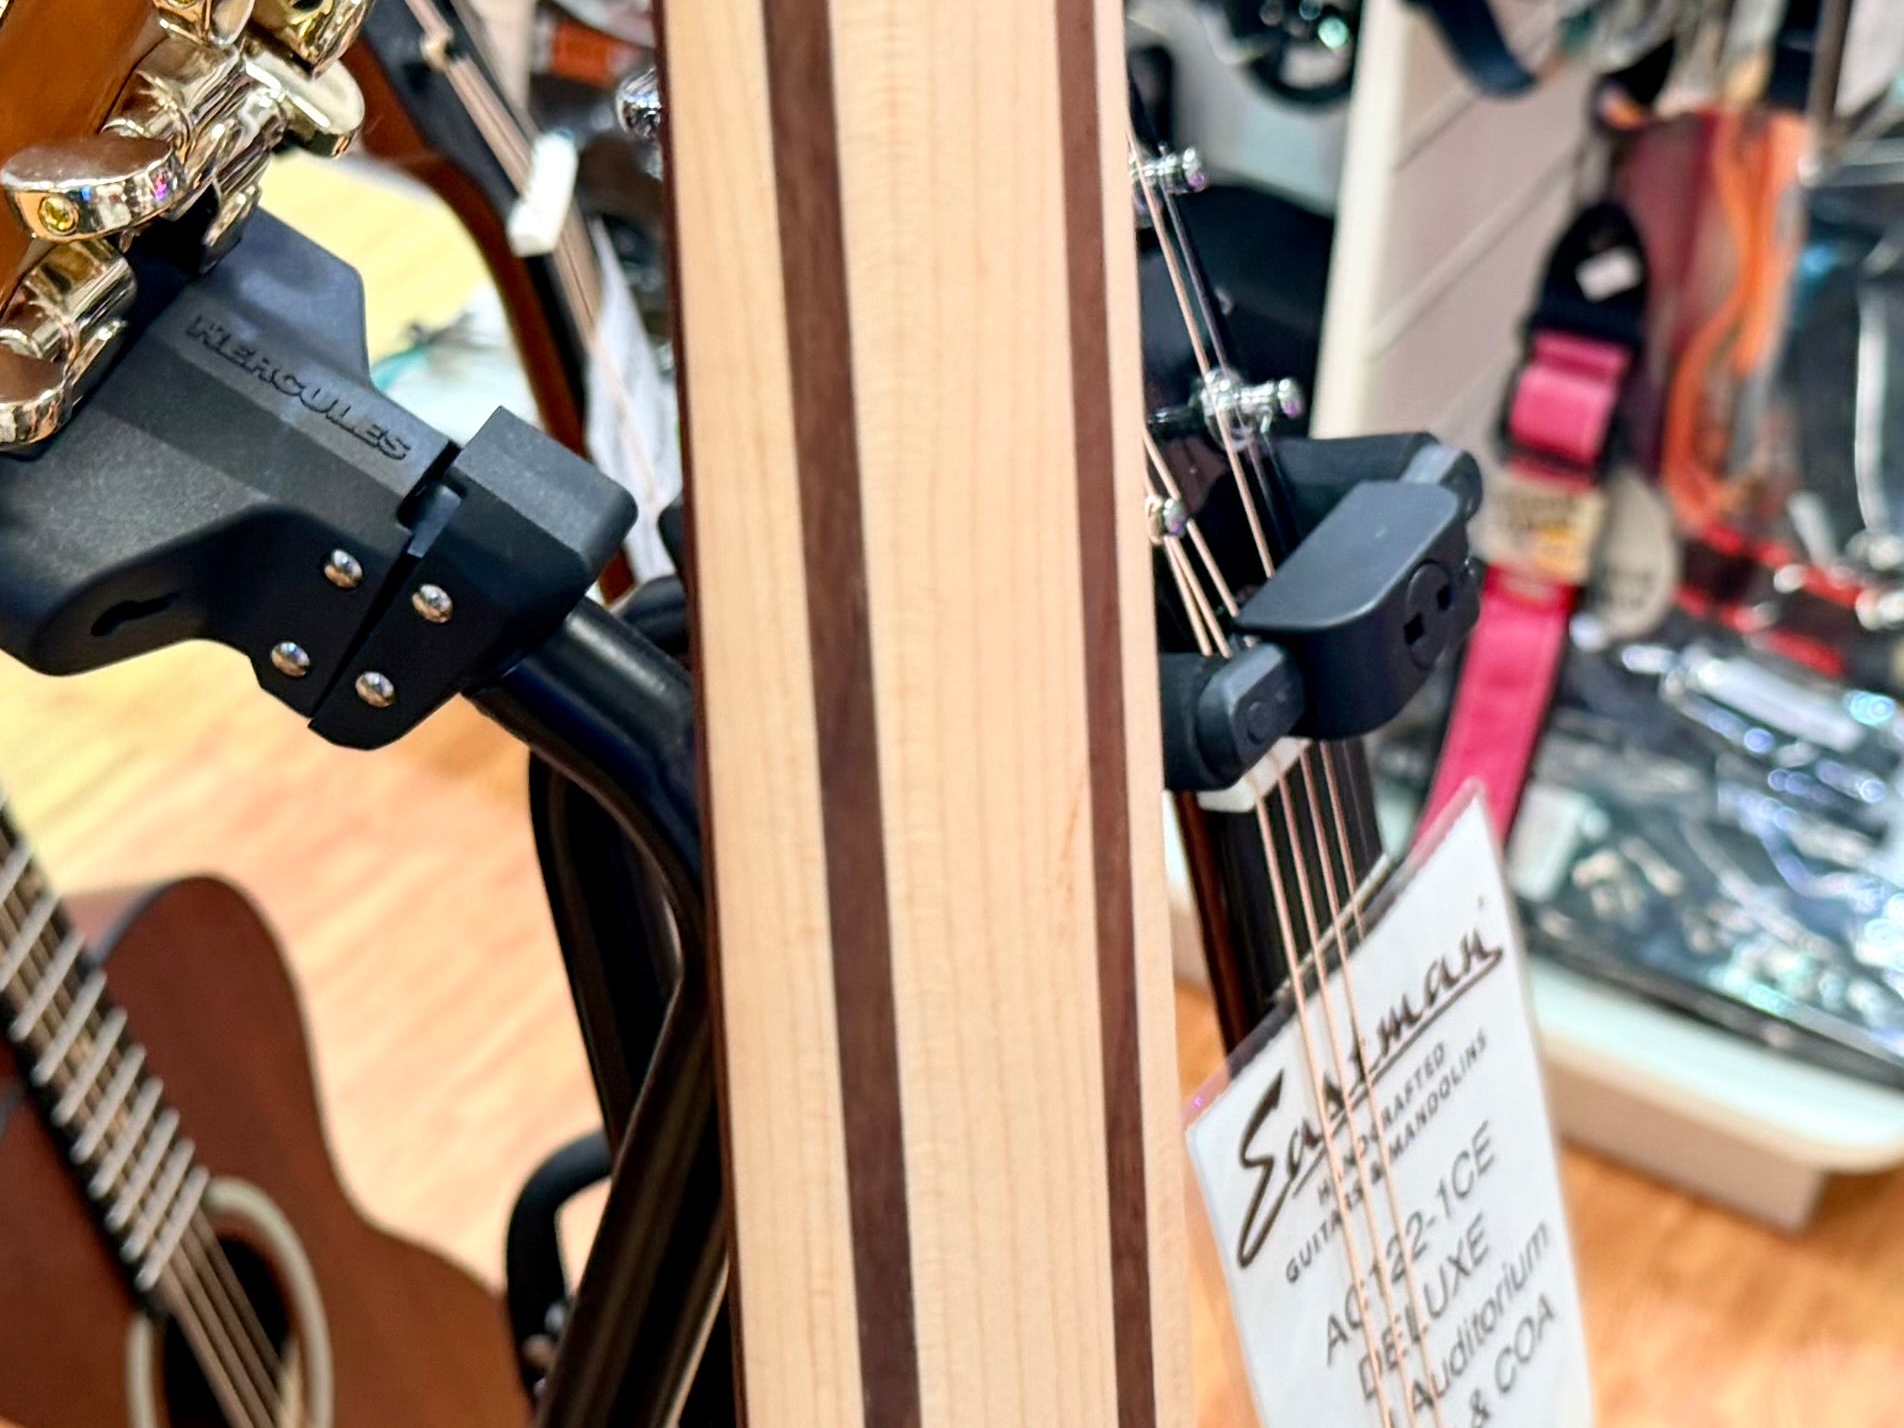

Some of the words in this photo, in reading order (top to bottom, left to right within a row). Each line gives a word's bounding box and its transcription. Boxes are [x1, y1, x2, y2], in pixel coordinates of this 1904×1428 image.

[186, 315, 412, 461] HERCULES
[1237, 926, 1503, 1269] Eastman
[1317, 1041, 1447, 1208] HNDCRAFTED
[1389, 1027, 1488, 1166] MANDOLINS
[1358, 1212, 1490, 1403] DELUXE
[1411, 1220, 1551, 1414] Auditorium
[1494, 1290, 1556, 1394] COA
